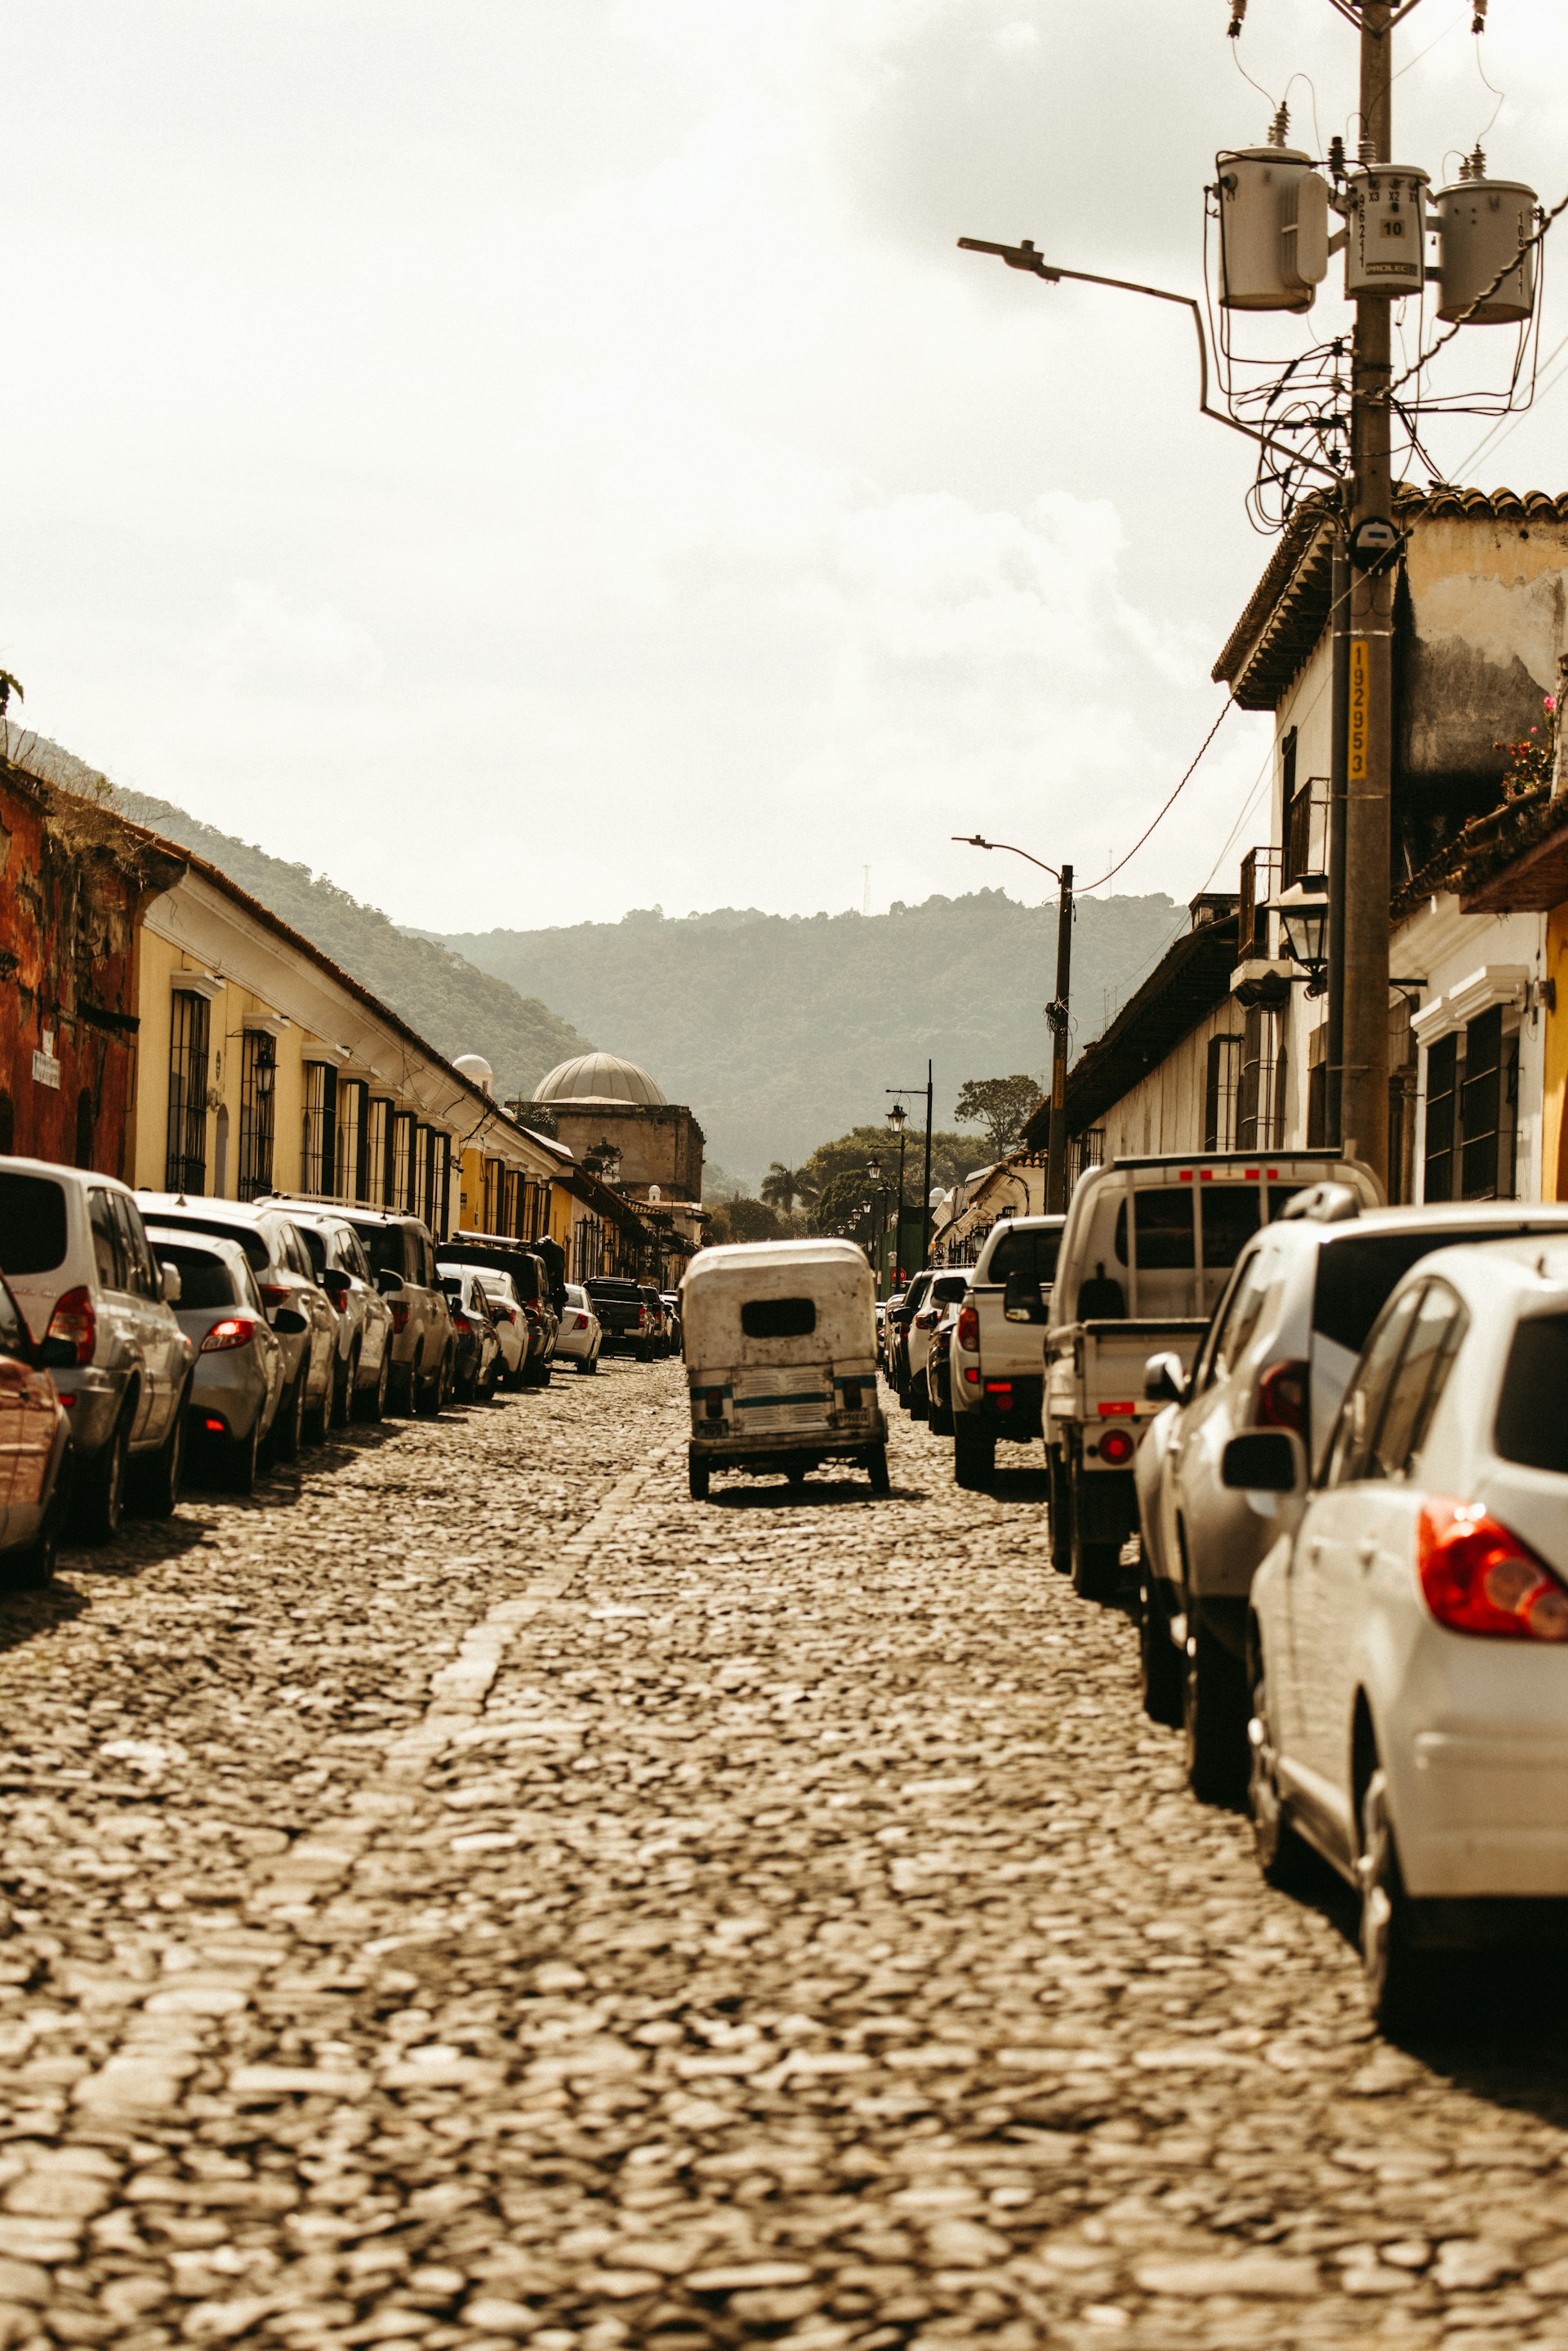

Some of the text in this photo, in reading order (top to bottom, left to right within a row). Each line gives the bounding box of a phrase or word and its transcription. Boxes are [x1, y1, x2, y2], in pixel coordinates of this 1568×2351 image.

[1369, 192, 1379, 202] X3
[1389, 192, 1400, 202] X2
[1384, 222, 1401, 235] 10
[1352, 646, 1364, 773] 192953
